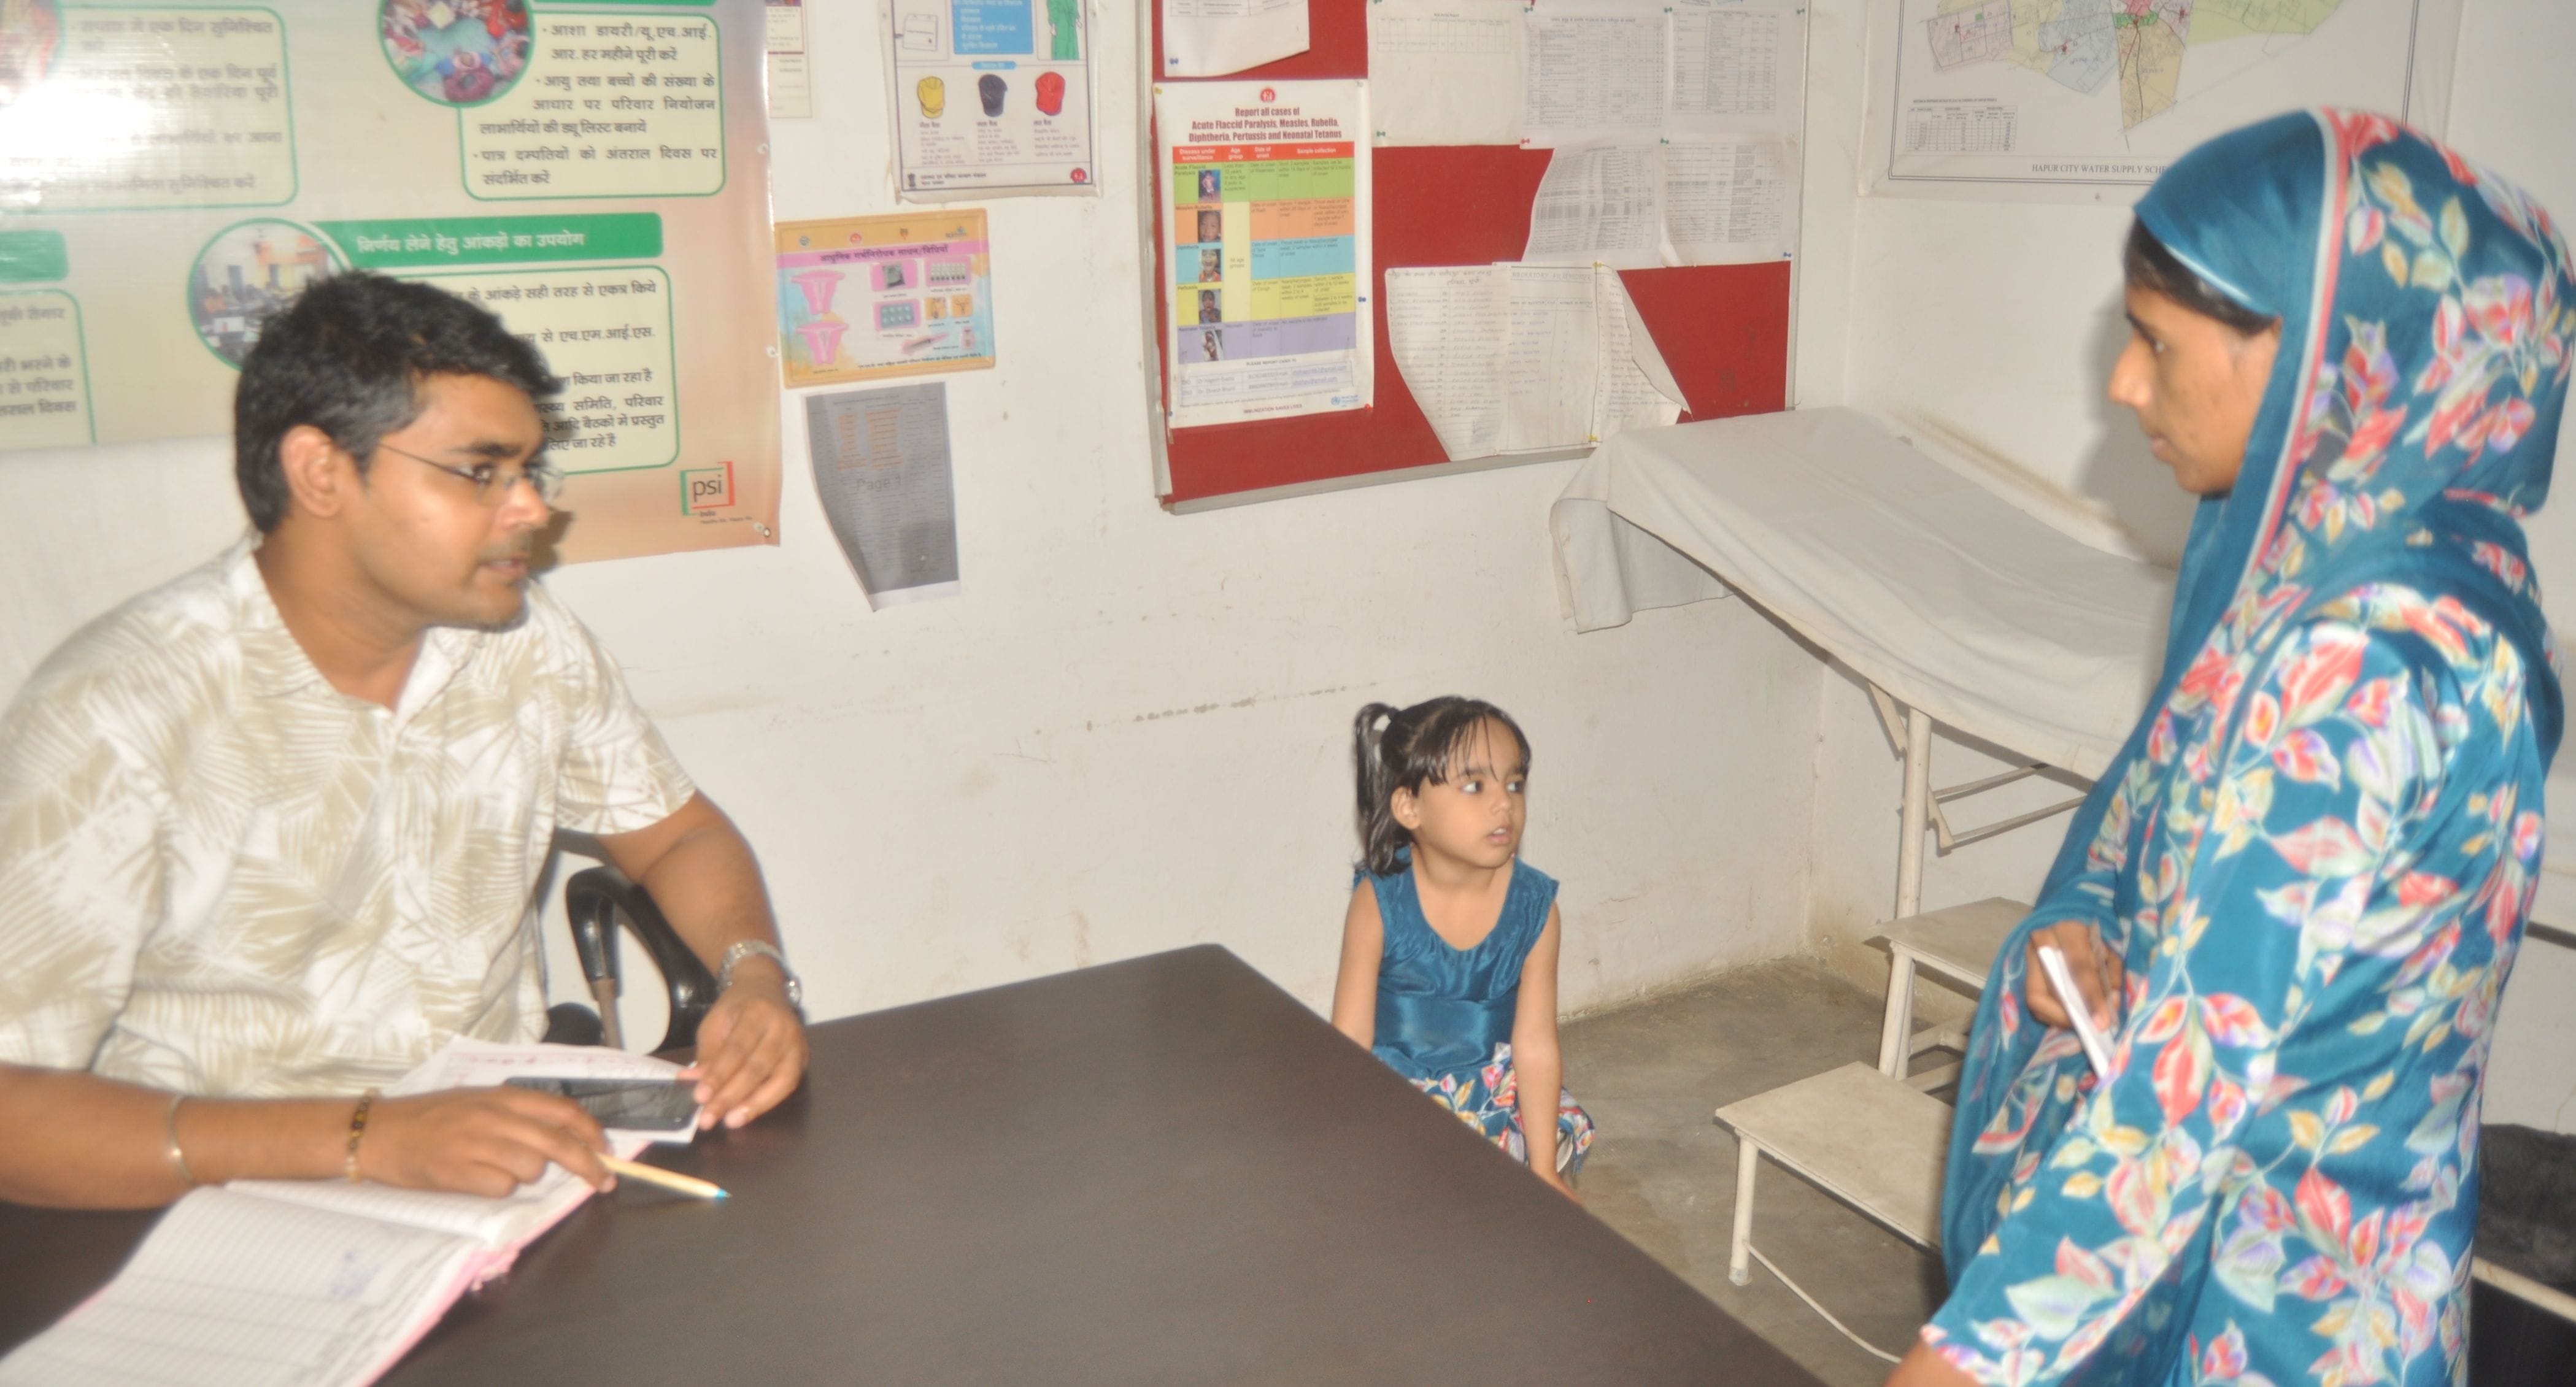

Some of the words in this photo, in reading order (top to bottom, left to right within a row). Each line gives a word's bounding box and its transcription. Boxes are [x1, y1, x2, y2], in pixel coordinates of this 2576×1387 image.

[552, 25, 585, 36] आशा
[582, 50, 598, 60] हर
[601, 46, 633, 60] महीने
[636, 46, 656, 64] पूरी
[658, 46, 677, 60] करें
[544, 77, 571, 90] आयु
[641, 74, 657, 87] की
[664, 73, 696, 87] संख्या
[703, 74, 715, 87] के
[533, 99, 574, 110] आधार
[585, 99, 601, 110] पर
[611, 96, 654, 110] परिवार
[664, 96, 715, 110] नियोजन
[1235, 107, 1259, 117] Report
[543, 120, 560, 134] की
[581, 120, 611, 134] लिस्ट
[1192, 121, 1214, 129] Acute
[1216, 120, 1243, 129] Flaccid
[1244, 120, 1277, 129] Paralysis,
[1279, 119, 1309, 128] Measles,
[1311, 118, 1339, 126] Rubella,
[1189, 133, 1230, 142] Diphtheria,
[1233, 132, 1267, 141] Pertussis
[1282, 130, 1313, 139] Neonatal
[1315, 129, 1342, 138] Tetanus
[482, 150, 506, 161] पात्र
[580, 147, 596, 159] को
[607, 147, 650, 159] अंतराल
[660, 145, 692, 159] दिवस
[701, 148, 717, 158] पर
[2081, 164, 2109, 173] WATER
[2111, 165, 2142, 174] SUPPLY
[2145, 166, 2165, 174] SCHE
[531, 170, 550, 184] करें
[357, 235, 401, 253] निर्णय
[404, 234, 431, 251] लेने
[435, 232, 458, 255] हेतु
[512, 234, 532, 247] का
[536, 229, 584, 247] उपयोग
[526, 284, 548, 299] सही
[553, 286, 577, 298] तरह
[582, 282, 593, 296] से
[598, 283, 627, 296] एकत्र
[631, 280, 656, 294] किये
[541, 329, 553, 342] से
[573, 372, 602, 386] किया
[605, 373, 620, 384] जा
[623, 371, 641, 383] रहा
[642, 367, 652, 383] है
[573, 396, 616, 411] समिति,
[624, 394, 664, 408] परिवार
[617, 414, 628, 427] में
[631, 415, 665, 429] प्रस्तुत
[572, 439, 587, 449] जा
[590, 434, 605, 448] रहे
[692, 474, 722, 502] psi
[857, 478, 890, 492] Page
